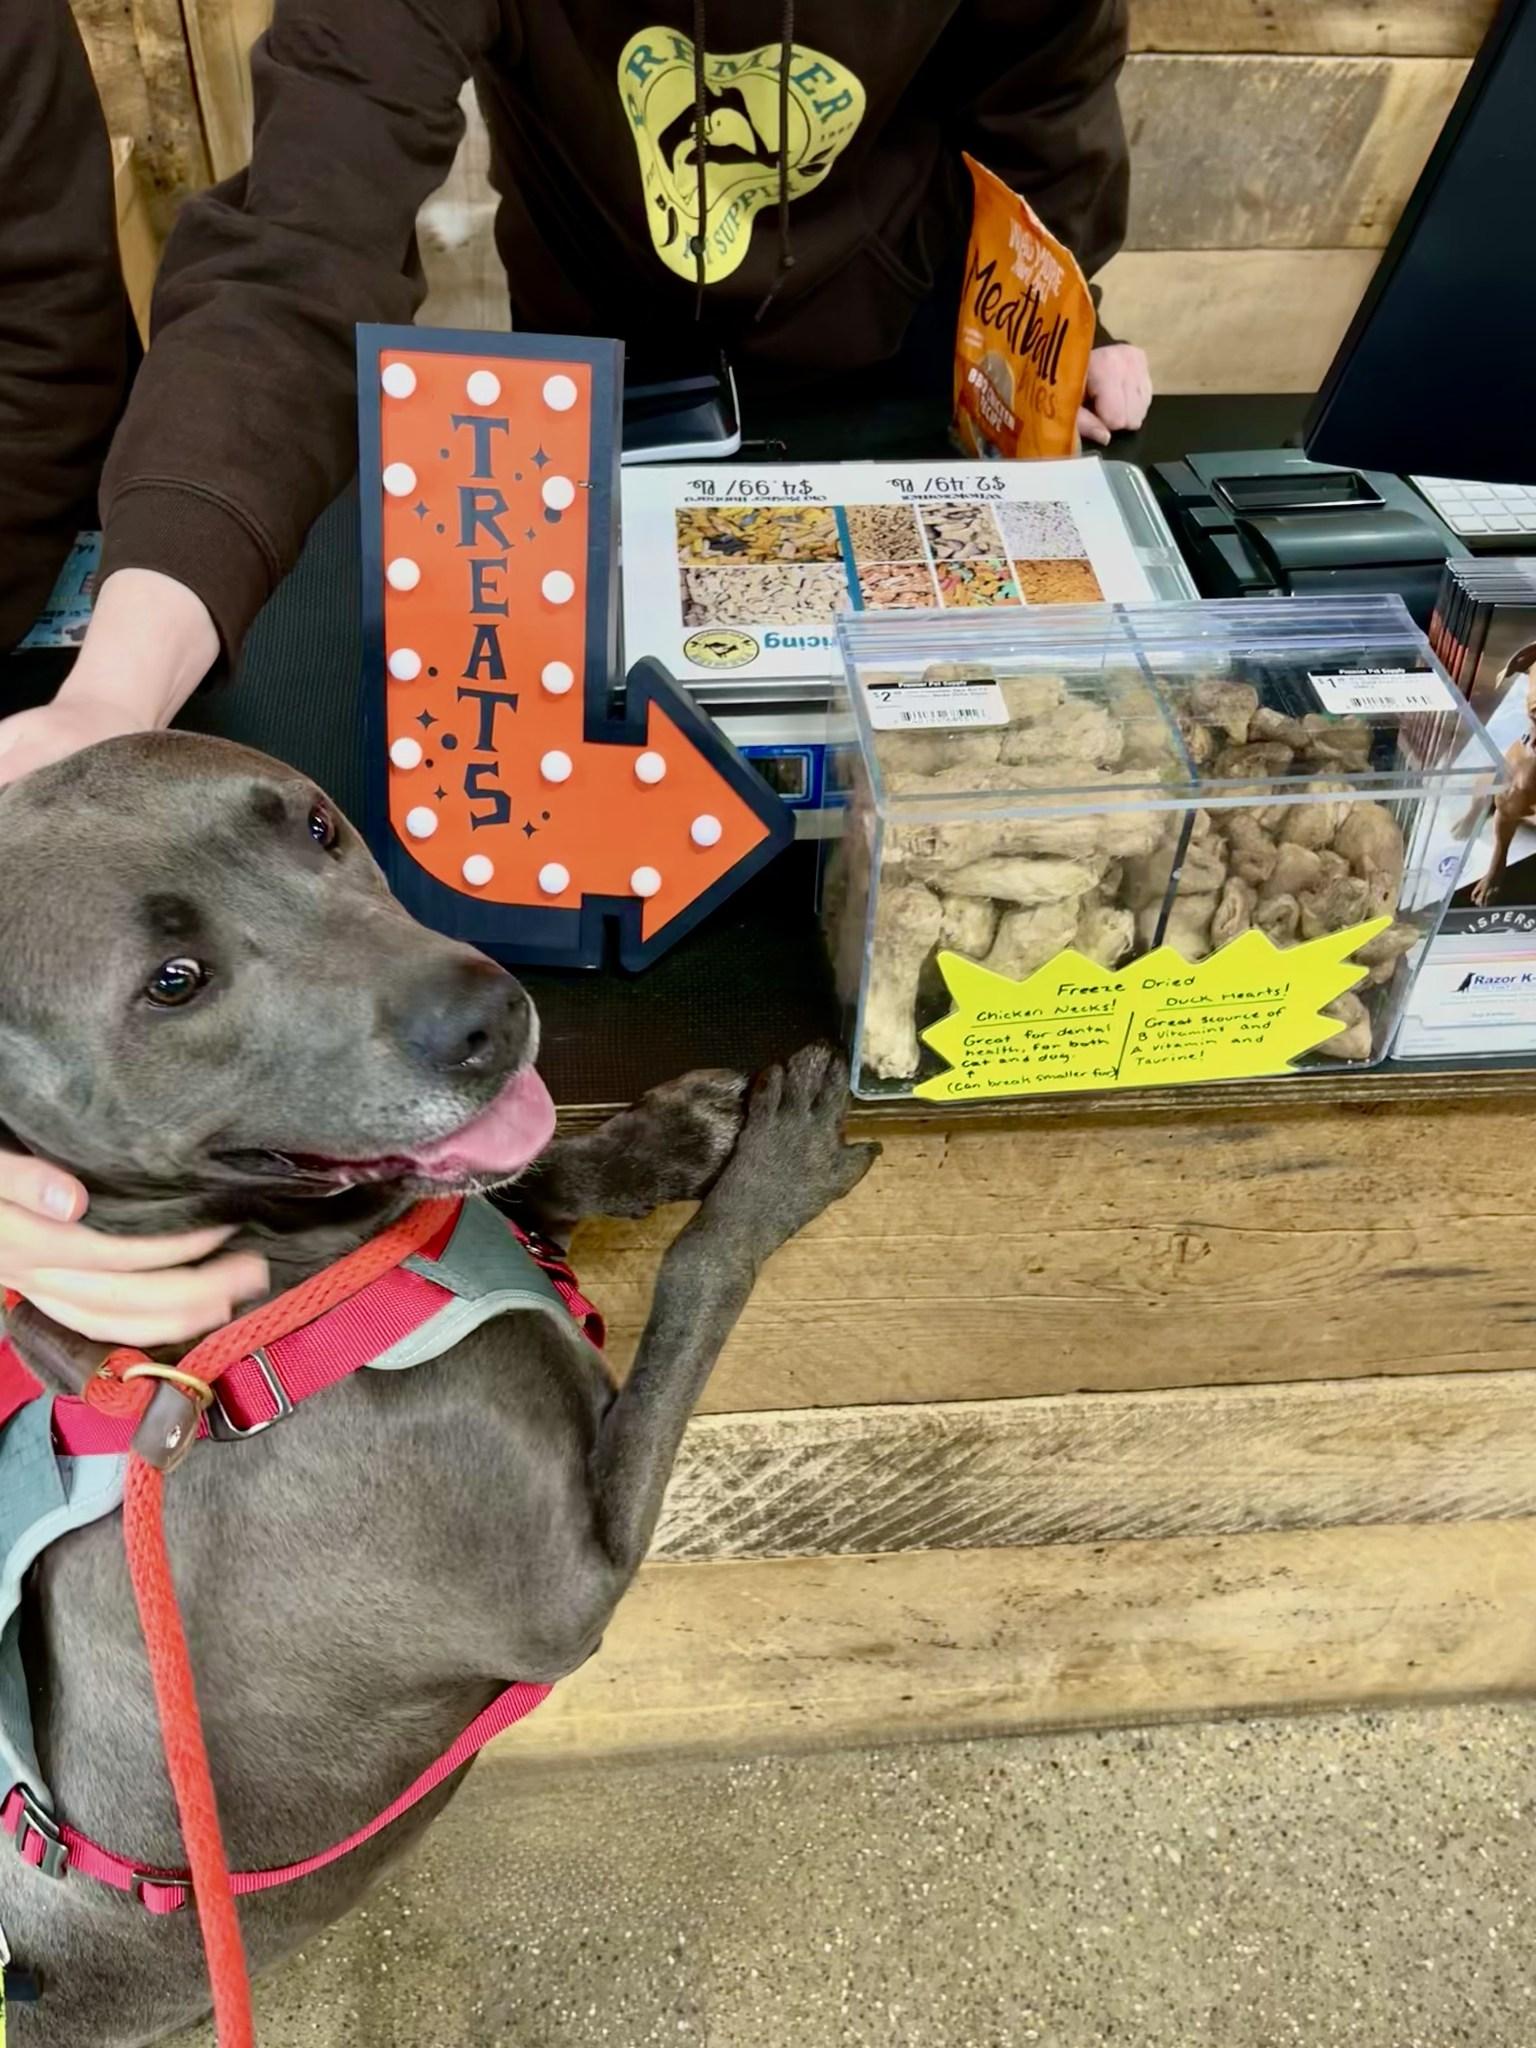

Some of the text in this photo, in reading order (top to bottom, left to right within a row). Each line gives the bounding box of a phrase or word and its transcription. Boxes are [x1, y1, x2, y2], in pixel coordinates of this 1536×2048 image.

[963, 246, 1069, 385] Meatball
[450, 414, 519, 832] TREATS
[1462, 911, 1536, 934] ISPERS
[1057, 976, 1196, 996] Freeze Dried
[1474, 975, 1516, 985] Razor
[1221, 983, 1291, 1000] Hearts!
[976, 998, 1118, 1022] Chicken Necks!
[1144, 1016, 1192, 1029] Great
[1267, 1006, 1287, 1018] of
[963, 1023, 1112, 1047] Great for dental
[1138, 1031, 1149, 1042] B
[1240, 1020, 1272, 1031] and
[1069, 1037, 1111, 1049] both
[1130, 1045, 1143, 1056] A
[1231, 1034, 1265, 1045] and
[999, 1053, 1031, 1065] and
[1136, 1050, 1205, 1066] Taurine!
[988, 1075, 1032, 1088] break
[1036, 1069, 1088, 1082] smaller
